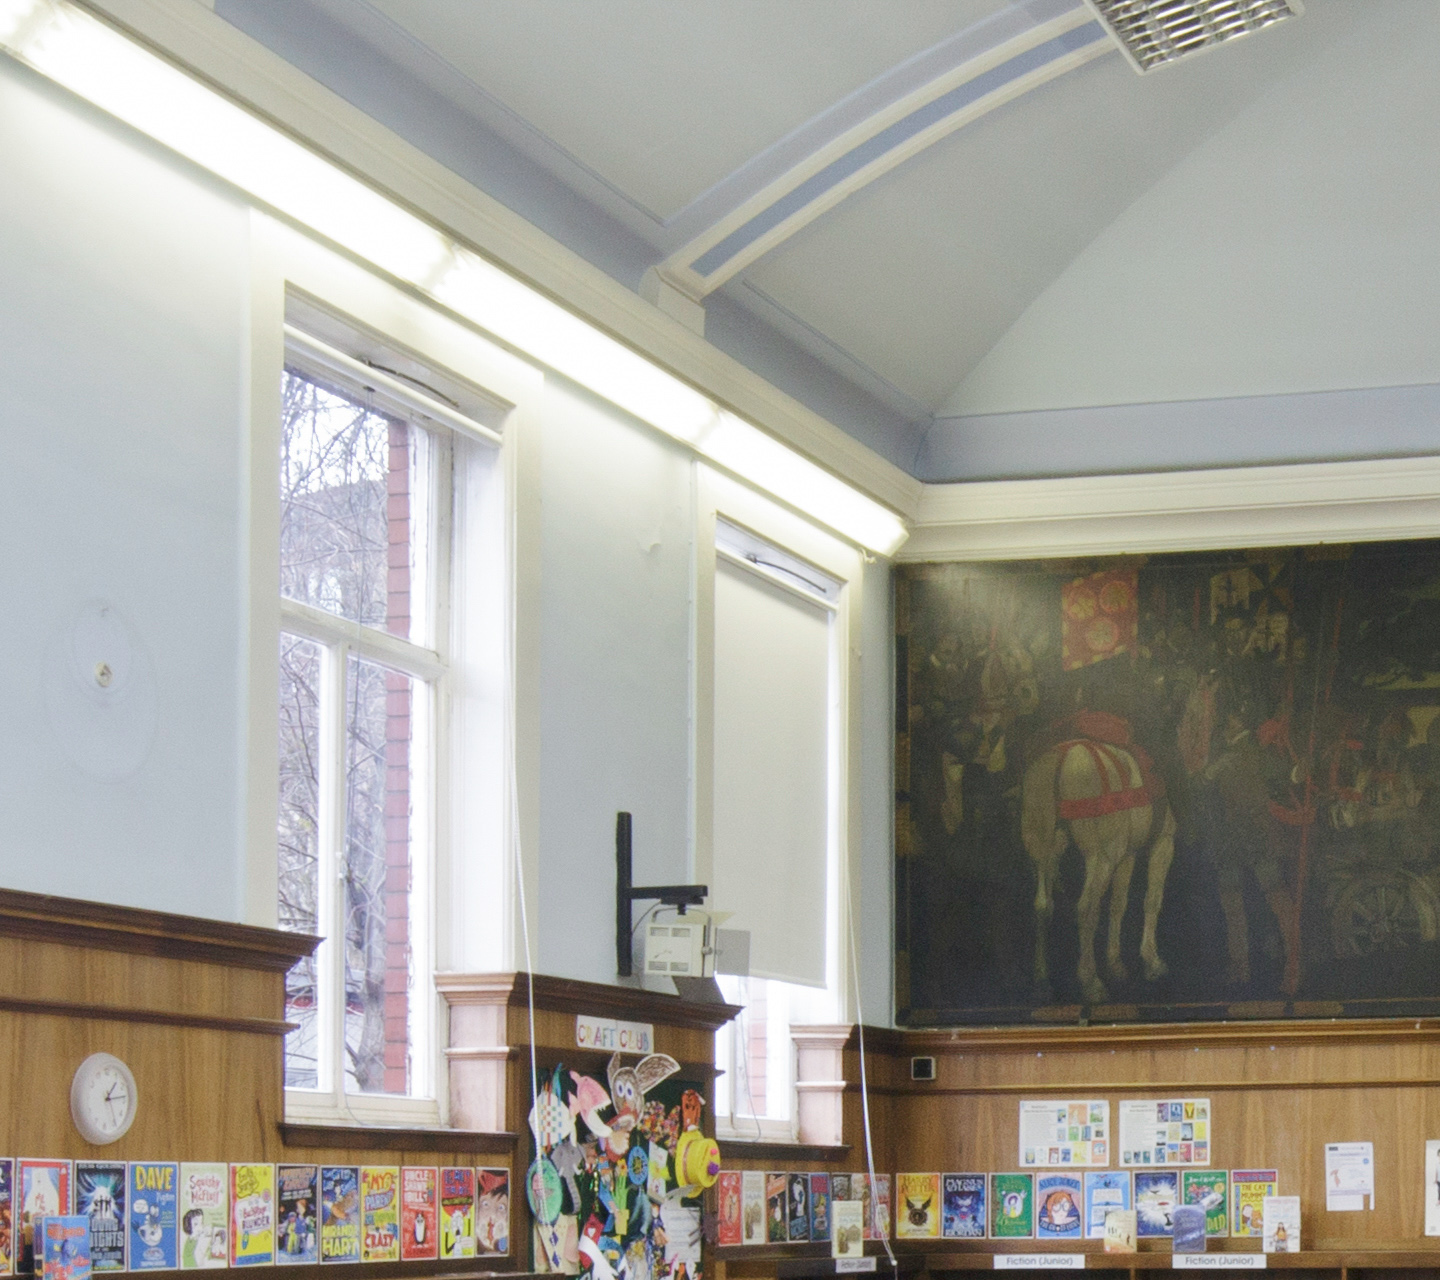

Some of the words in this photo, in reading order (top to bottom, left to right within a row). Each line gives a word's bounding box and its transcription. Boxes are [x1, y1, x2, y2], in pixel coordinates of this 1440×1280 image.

[578, 1023, 616, 1048] CRAFT
[135, 1165, 174, 1190] DAVE
[323, 1238, 359, 1255] HART
[1006, 1256, 1036, 1266] Fiction
[1039, 1256, 1075, 1267] (Junior)
[1185, 1256, 1217, 1266] Fiction
[1218, 1256, 1255, 1267] (Junior)
